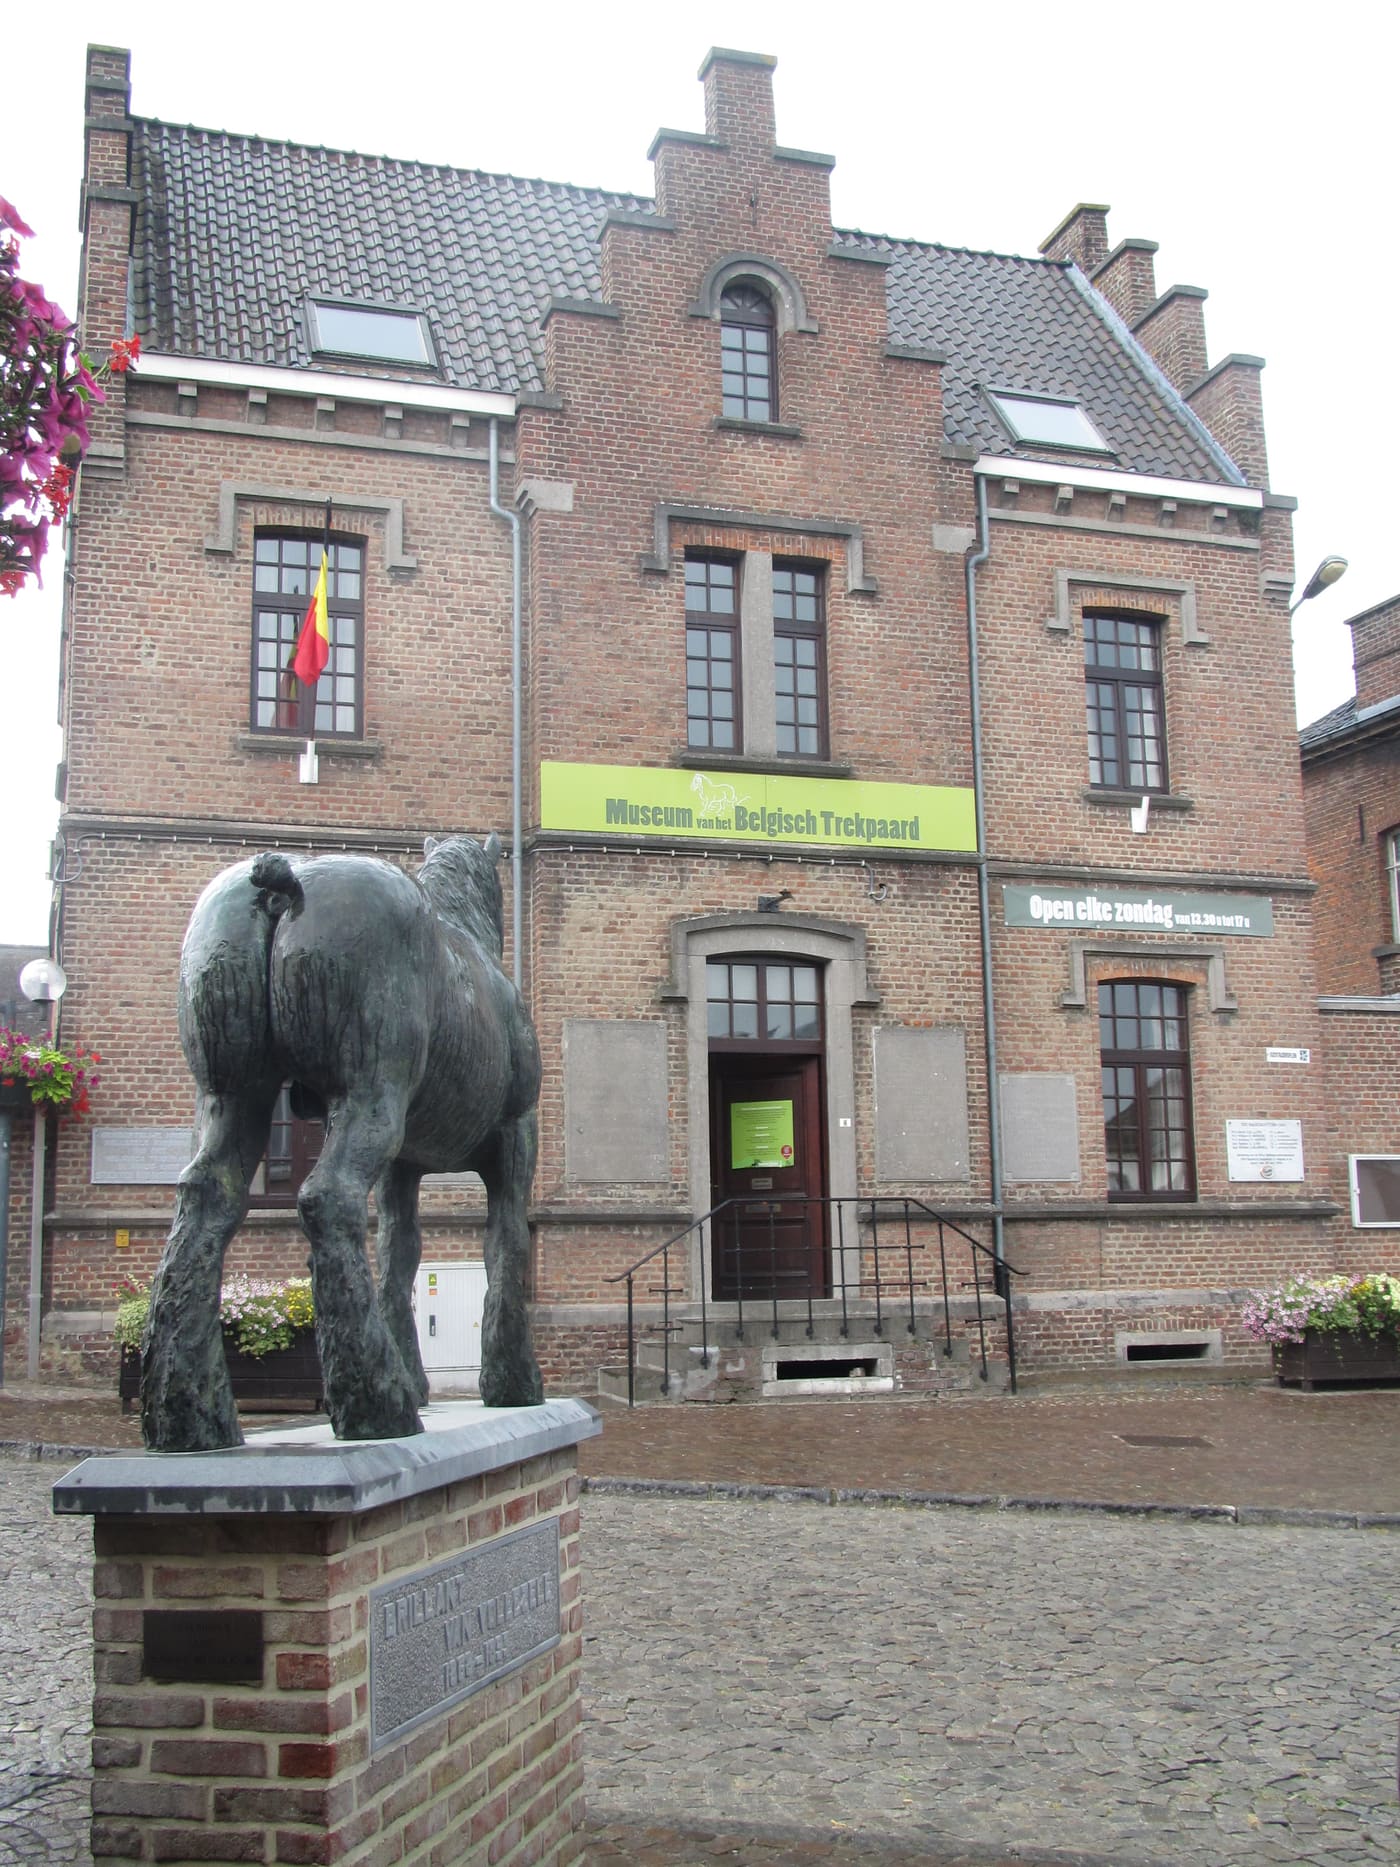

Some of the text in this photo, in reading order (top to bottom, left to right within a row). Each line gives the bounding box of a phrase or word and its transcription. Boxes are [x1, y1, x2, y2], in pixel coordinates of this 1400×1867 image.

[606, 798, 920, 842] Museum van het Belgisch Trekpaard
[1029, 895, 1074, 923] Open
[1076, 896, 1113, 922] elke
[1115, 899, 1174, 929] zondag
[1174, 914, 1190, 925] van
[1190, 912, 1215, 926] 13.30
[1222, 915, 1234, 927] tot
[1235, 915, 1244, 928] 17
[444, 1609, 474, 1653] VAN
